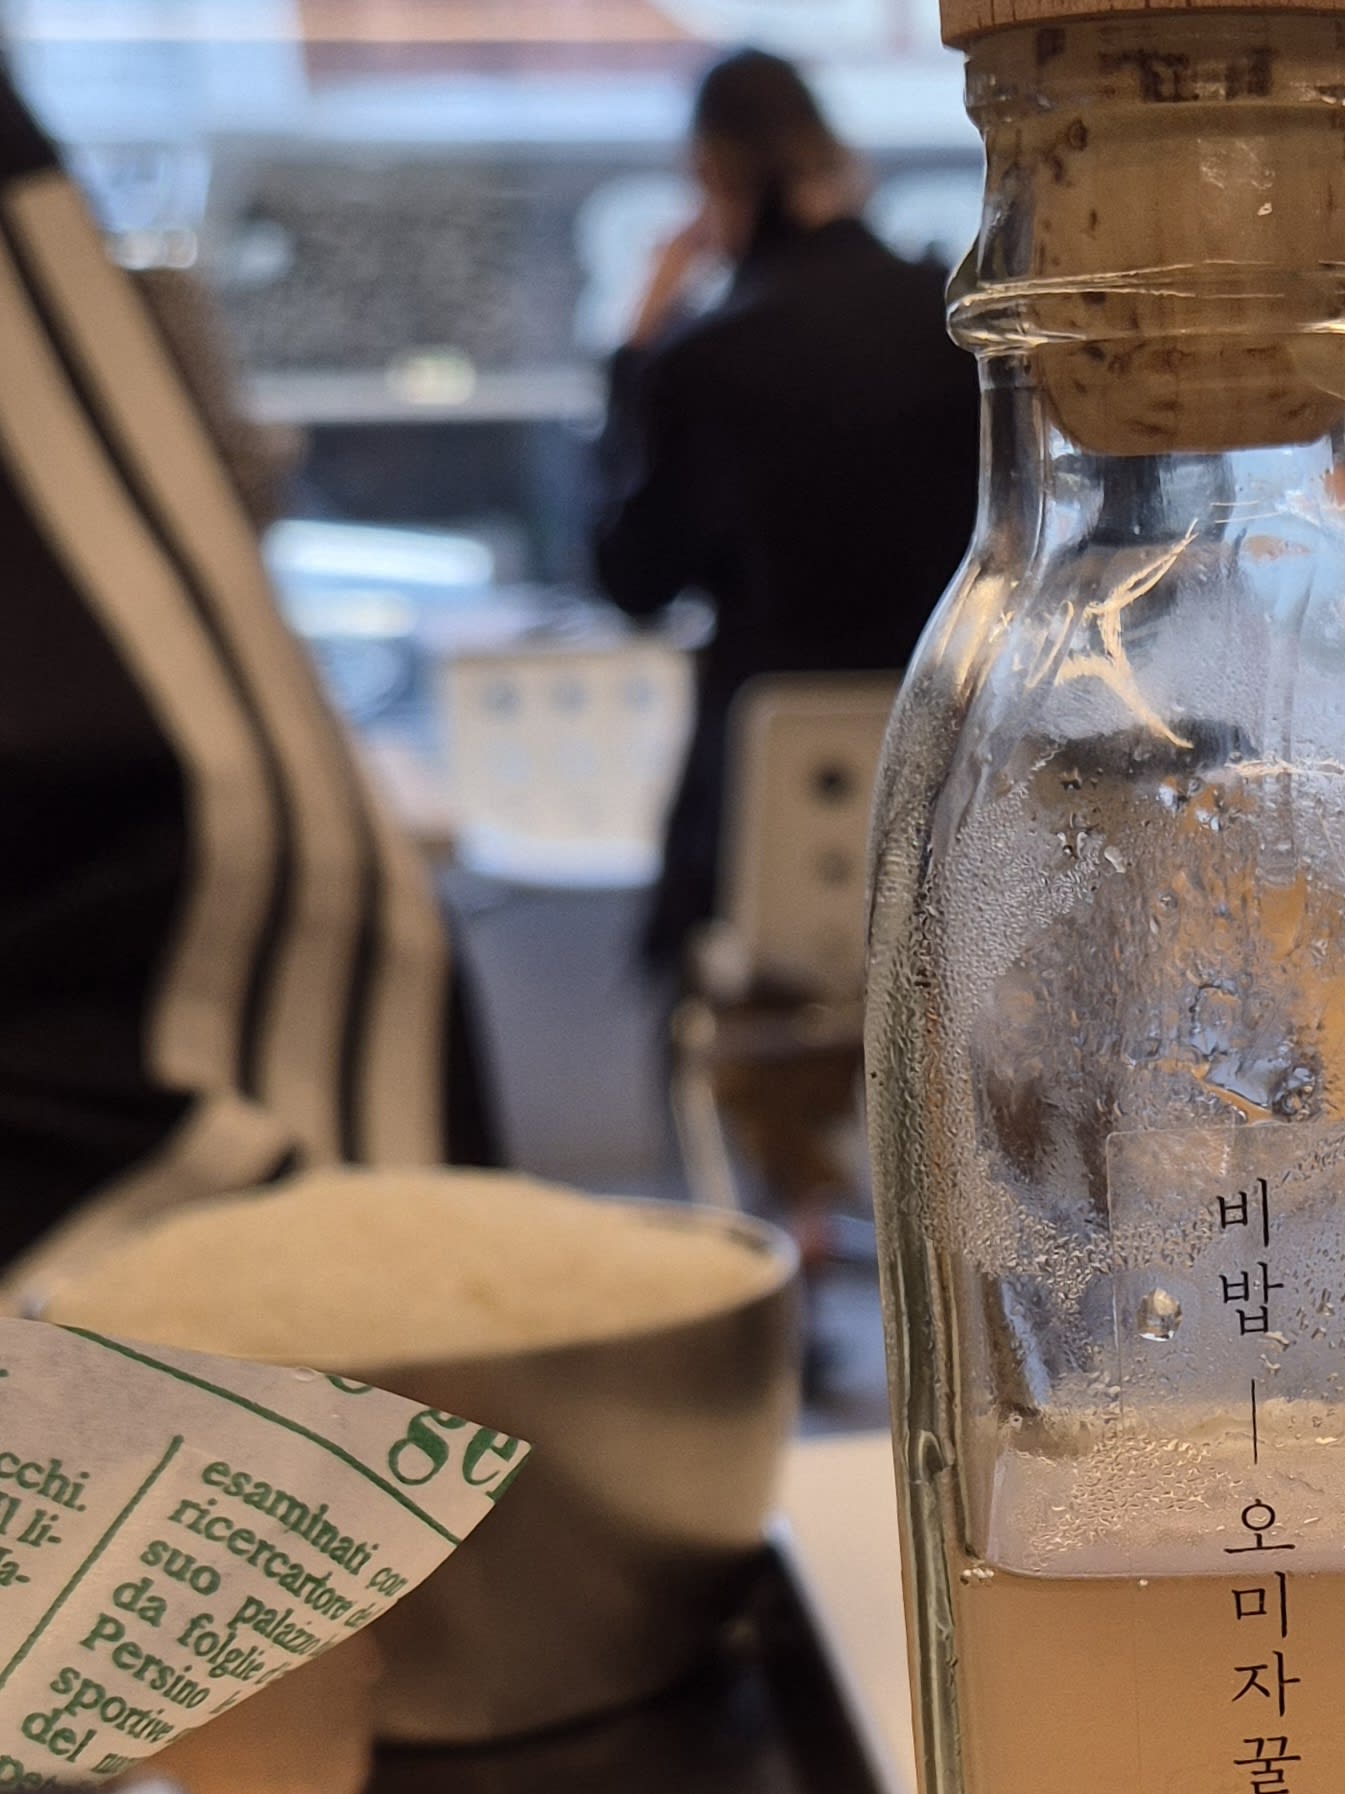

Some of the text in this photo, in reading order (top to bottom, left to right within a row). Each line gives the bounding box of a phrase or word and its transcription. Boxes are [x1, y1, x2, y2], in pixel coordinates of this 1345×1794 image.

[1216, 1177, 1284, 1336] 비밥
[168, 1499, 353, 1621] ricercartore
[202, 1461, 379, 1576] esaminati
[113, 1577, 265, 1681] da folglie
[140, 1540, 320, 1655] suo palazzo
[50, 1667, 175, 1743] sportive
[80, 1612, 211, 1709] Persino
[21, 1708, 97, 1763] del
